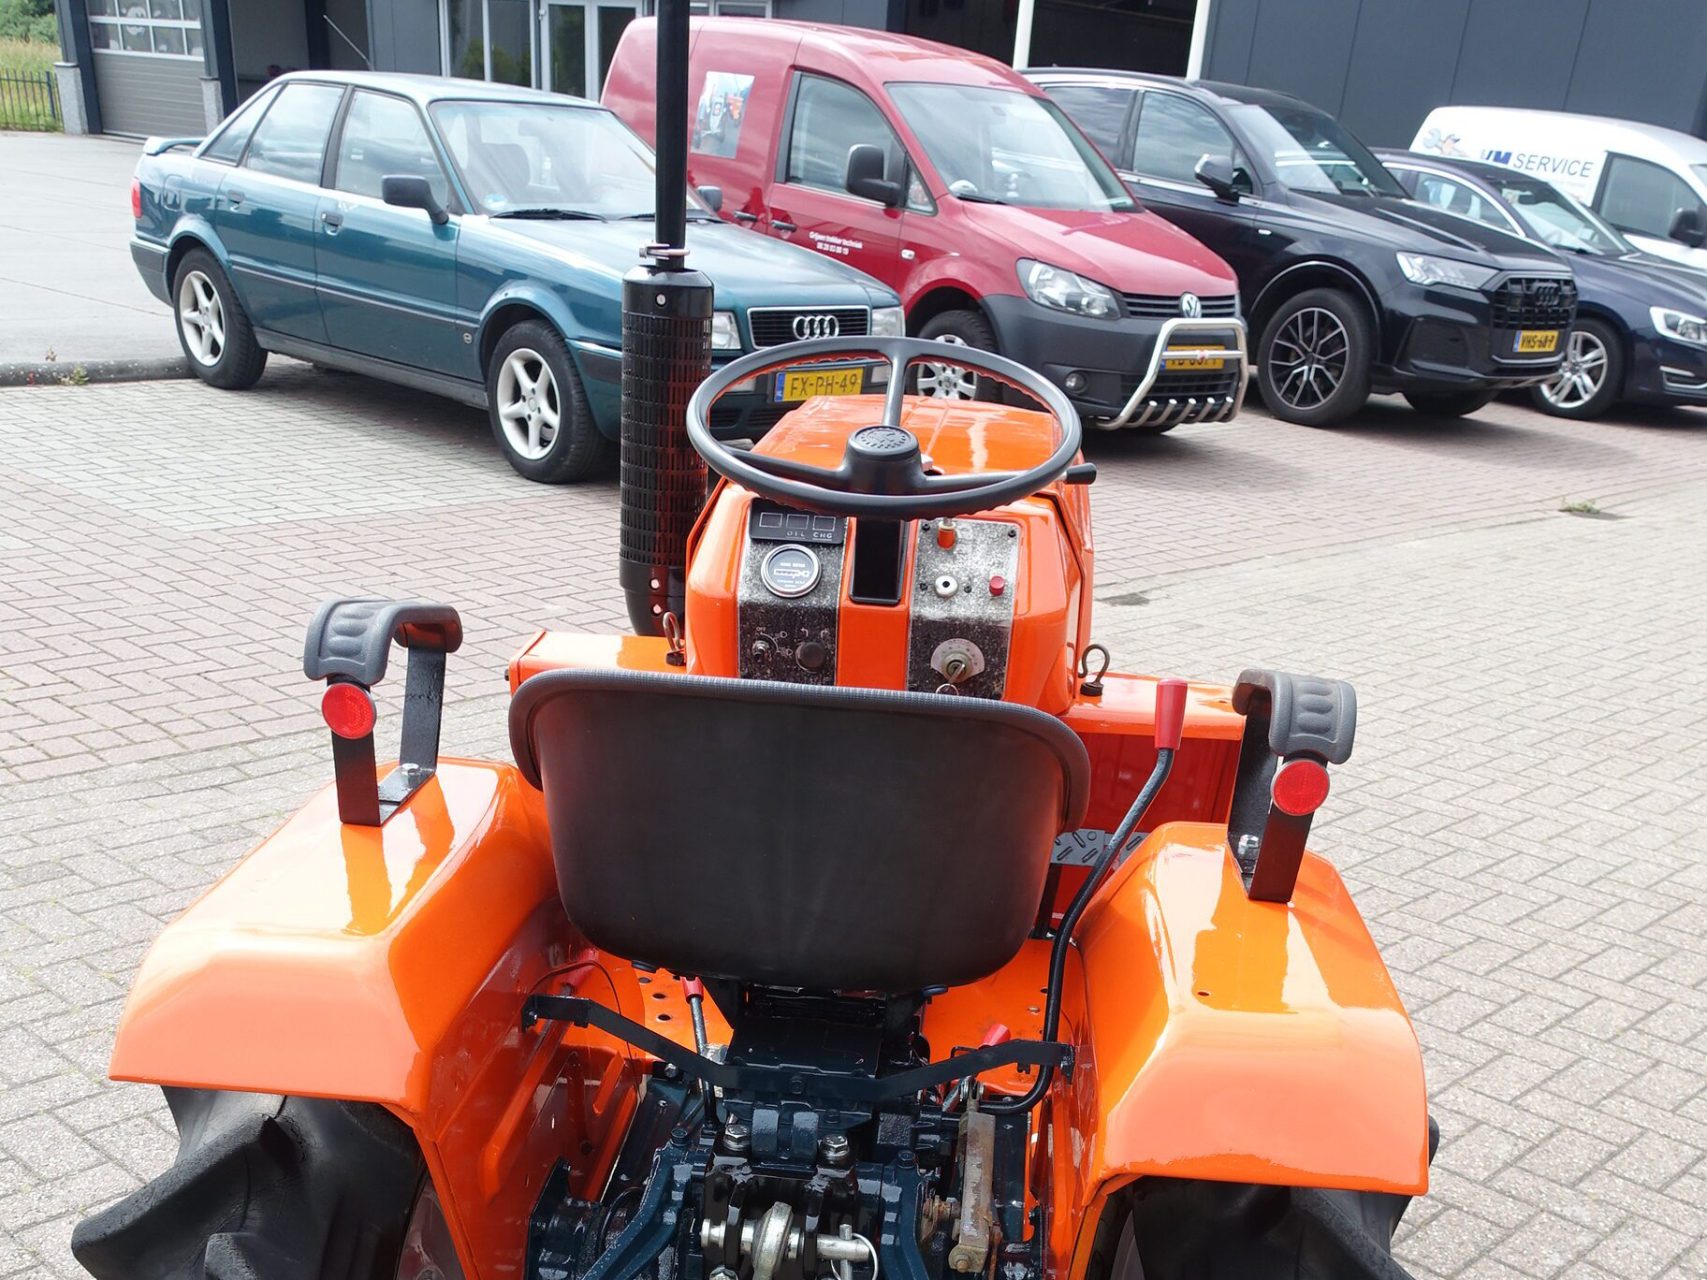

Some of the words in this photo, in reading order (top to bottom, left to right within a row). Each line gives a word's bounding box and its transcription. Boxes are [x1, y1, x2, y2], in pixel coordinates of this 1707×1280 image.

[1513, 153, 1594, 178] SERVICE
[790, 373, 857, 397] FX-PH-49
[786, 530, 805, 538] OIL
[812, 531, 833, 539] CHG
